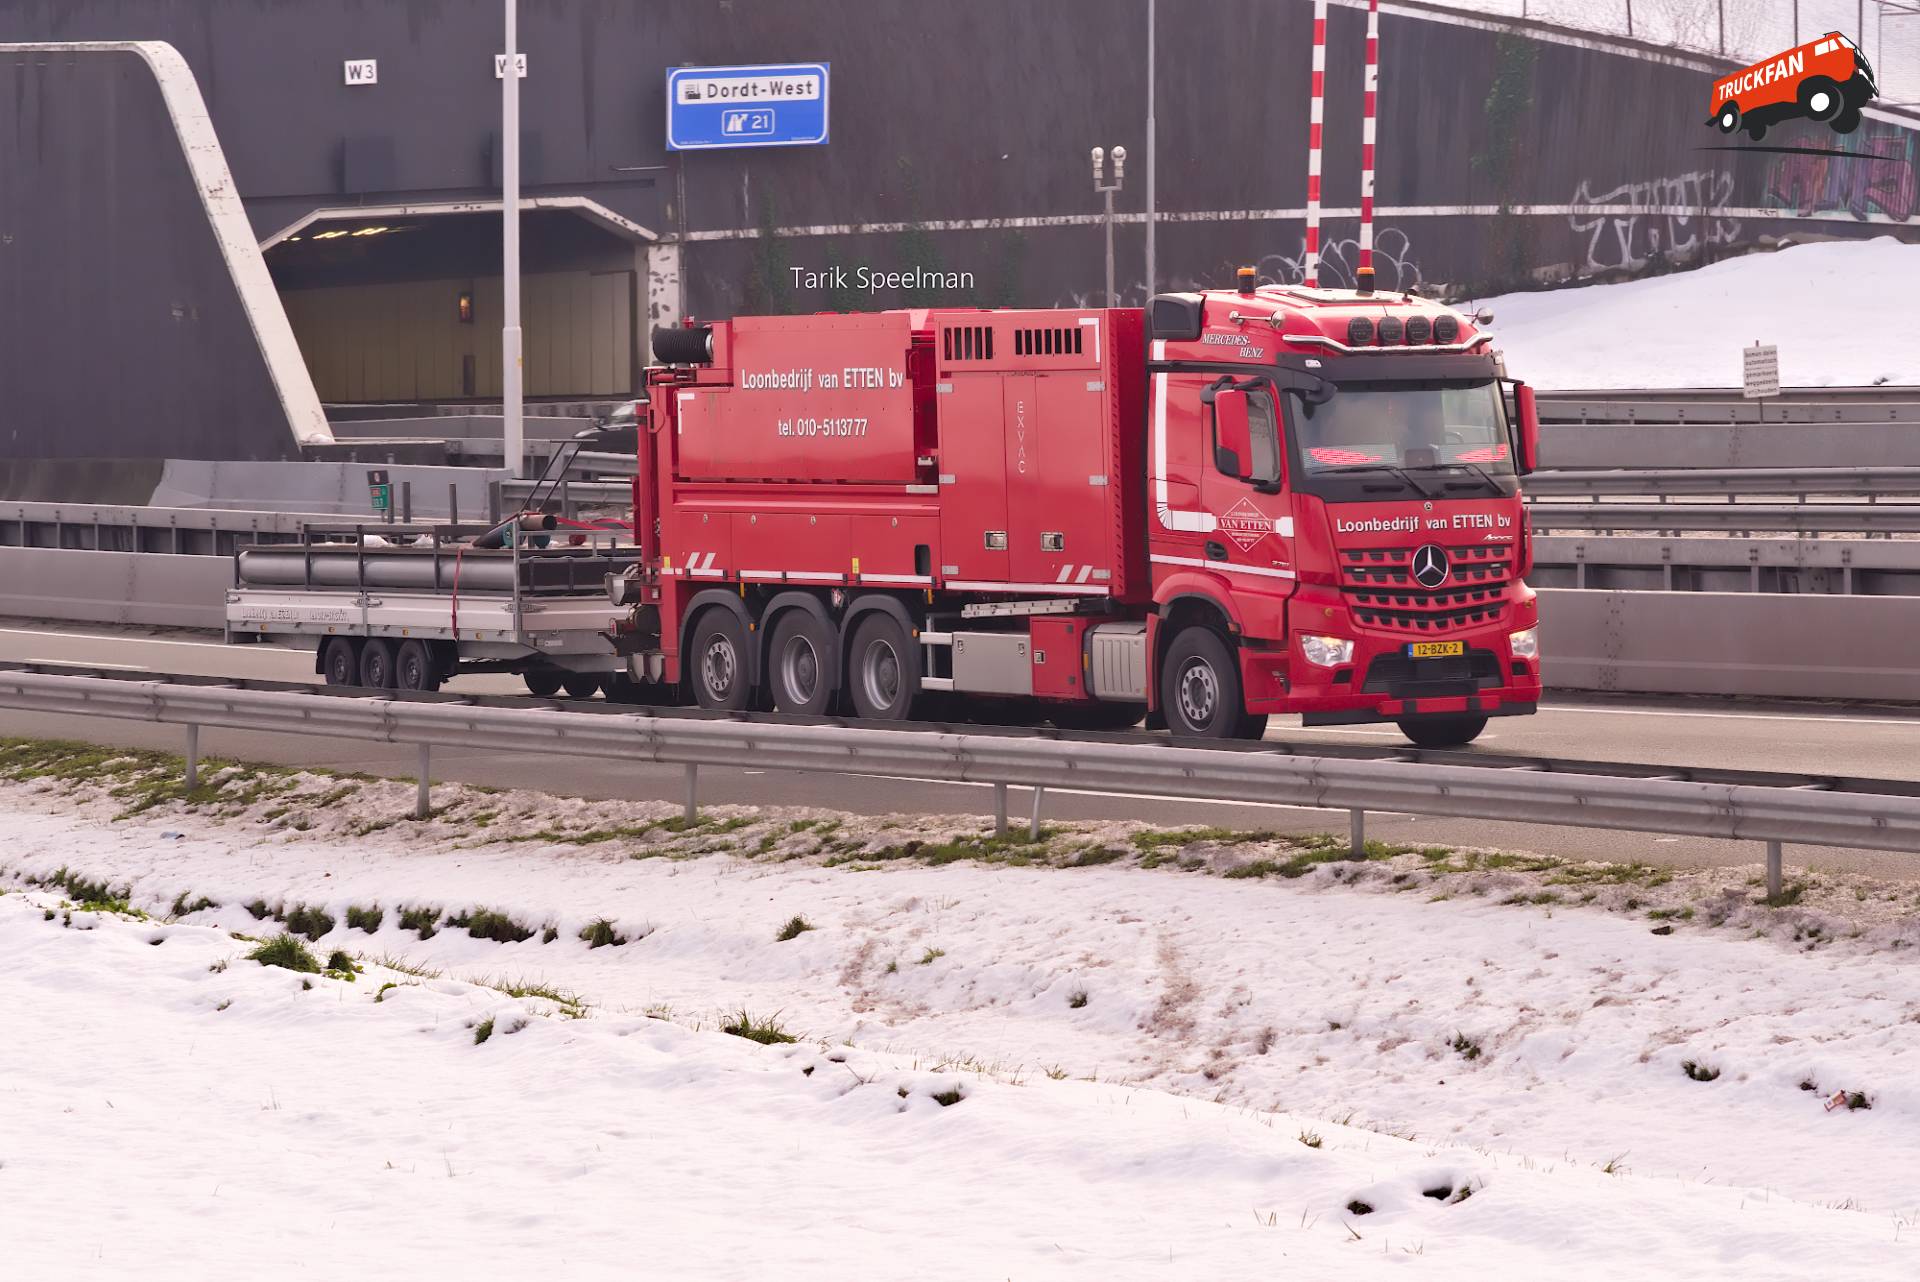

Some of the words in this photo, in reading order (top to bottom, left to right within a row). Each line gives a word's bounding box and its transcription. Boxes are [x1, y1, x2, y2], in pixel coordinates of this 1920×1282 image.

[348, 64, 374, 80] W3
[707, 80, 813, 98] Dordt-West
[751, 115, 769, 129] 21
[1202, 333, 1251, 346] MERCEDES-
[1239, 347, 1264, 358] BENZ
[741, 368, 813, 392] Loonbedrijf
[818, 373, 838, 388] van
[843, 367, 884, 388] ETTEN
[888, 367, 904, 388] bv
[1220, 518, 1238, 529] VAN
[1240, 519, 1271, 530] ETTEN
[1336, 516, 1420, 533] Loonbedrijf
[1426, 518, 1448, 530] van
[1453, 514, 1493, 529] ETTEN
[1498, 513, 1511, 528] bv
[1417, 643, 1459, 655] 12-BZK-2
